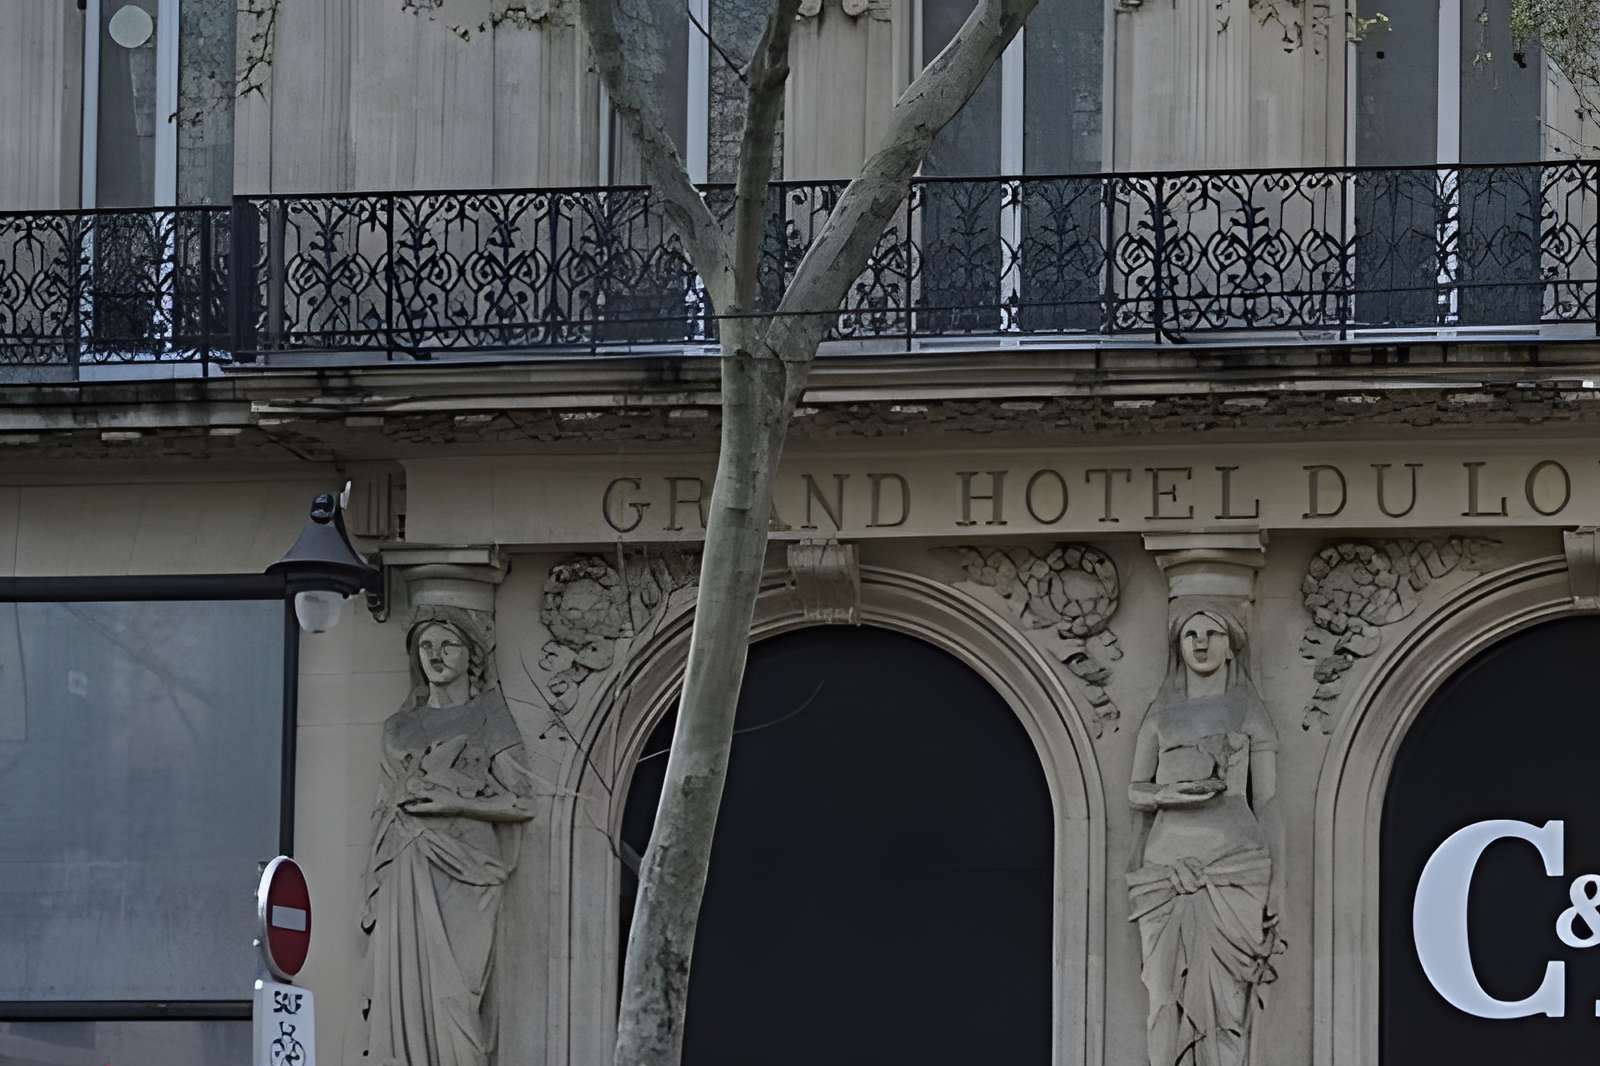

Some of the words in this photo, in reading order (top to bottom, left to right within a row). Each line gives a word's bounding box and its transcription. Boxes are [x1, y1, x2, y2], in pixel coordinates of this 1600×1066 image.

[602, 473, 912, 533] GRND
[955, 466, 1260, 527] HOTEL
[1301, 462, 1425, 519] DU
